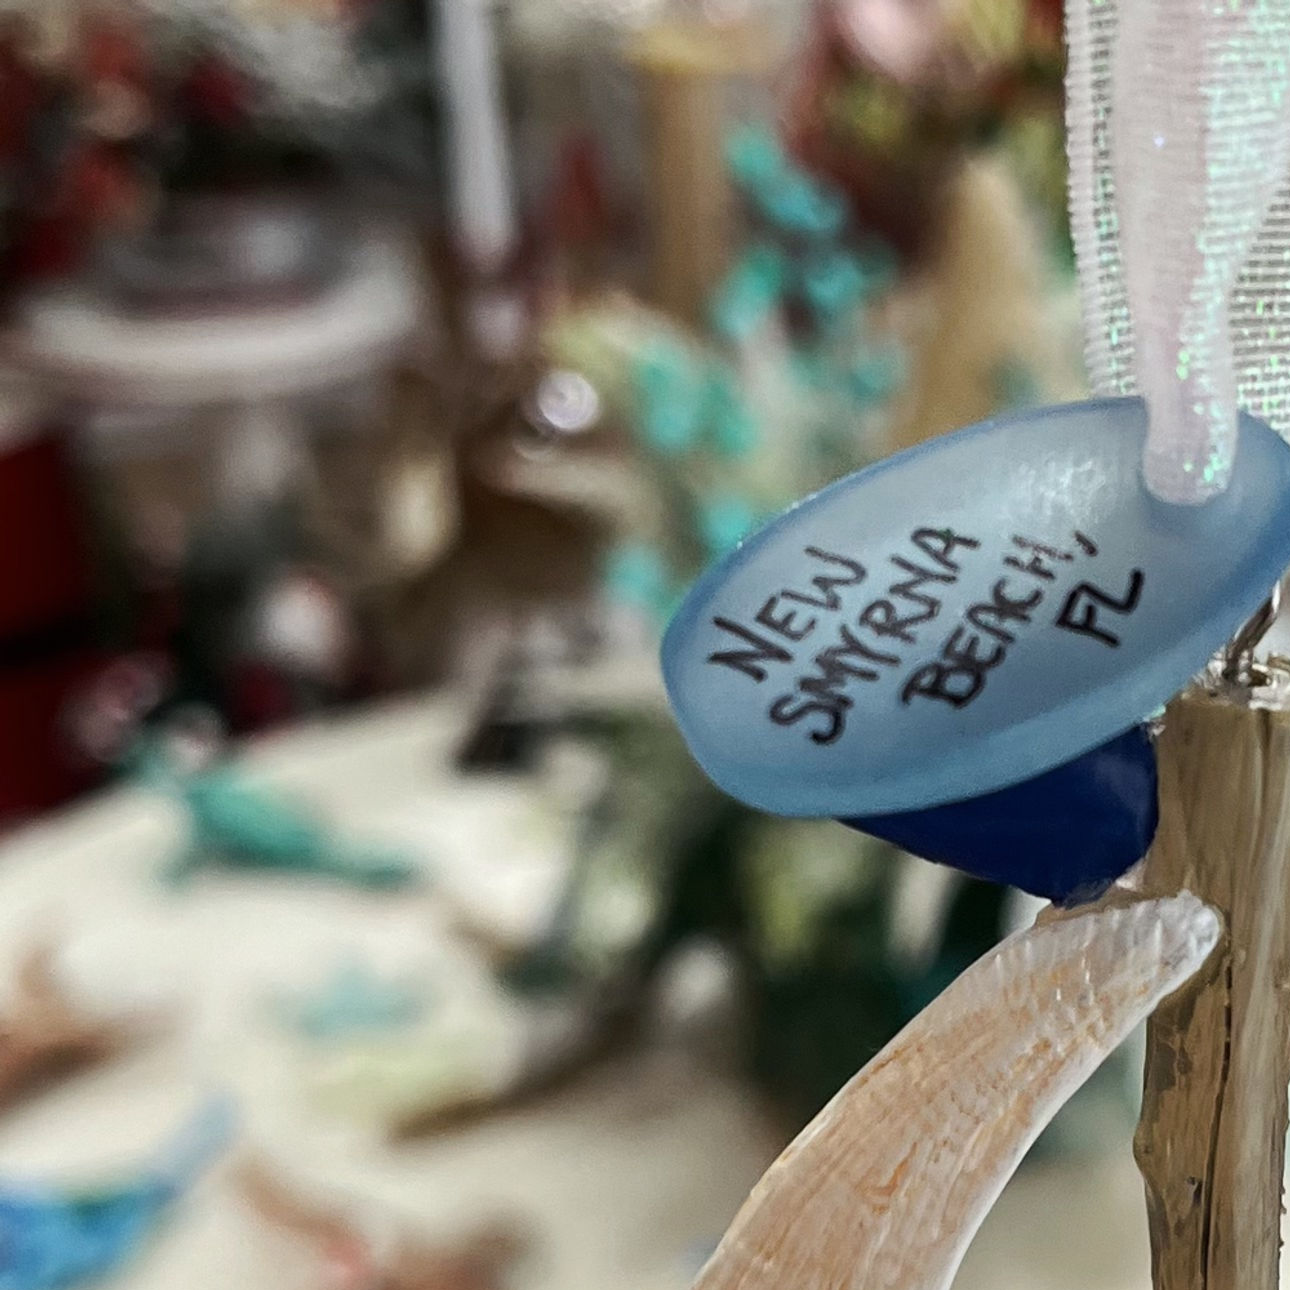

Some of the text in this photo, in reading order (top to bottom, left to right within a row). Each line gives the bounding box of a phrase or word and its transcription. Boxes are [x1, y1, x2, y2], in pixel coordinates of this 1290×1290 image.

[707, 545, 868, 683] NEW
[768, 526, 981, 747] SMYRNA
[1054, 567, 1146, 649] FL
